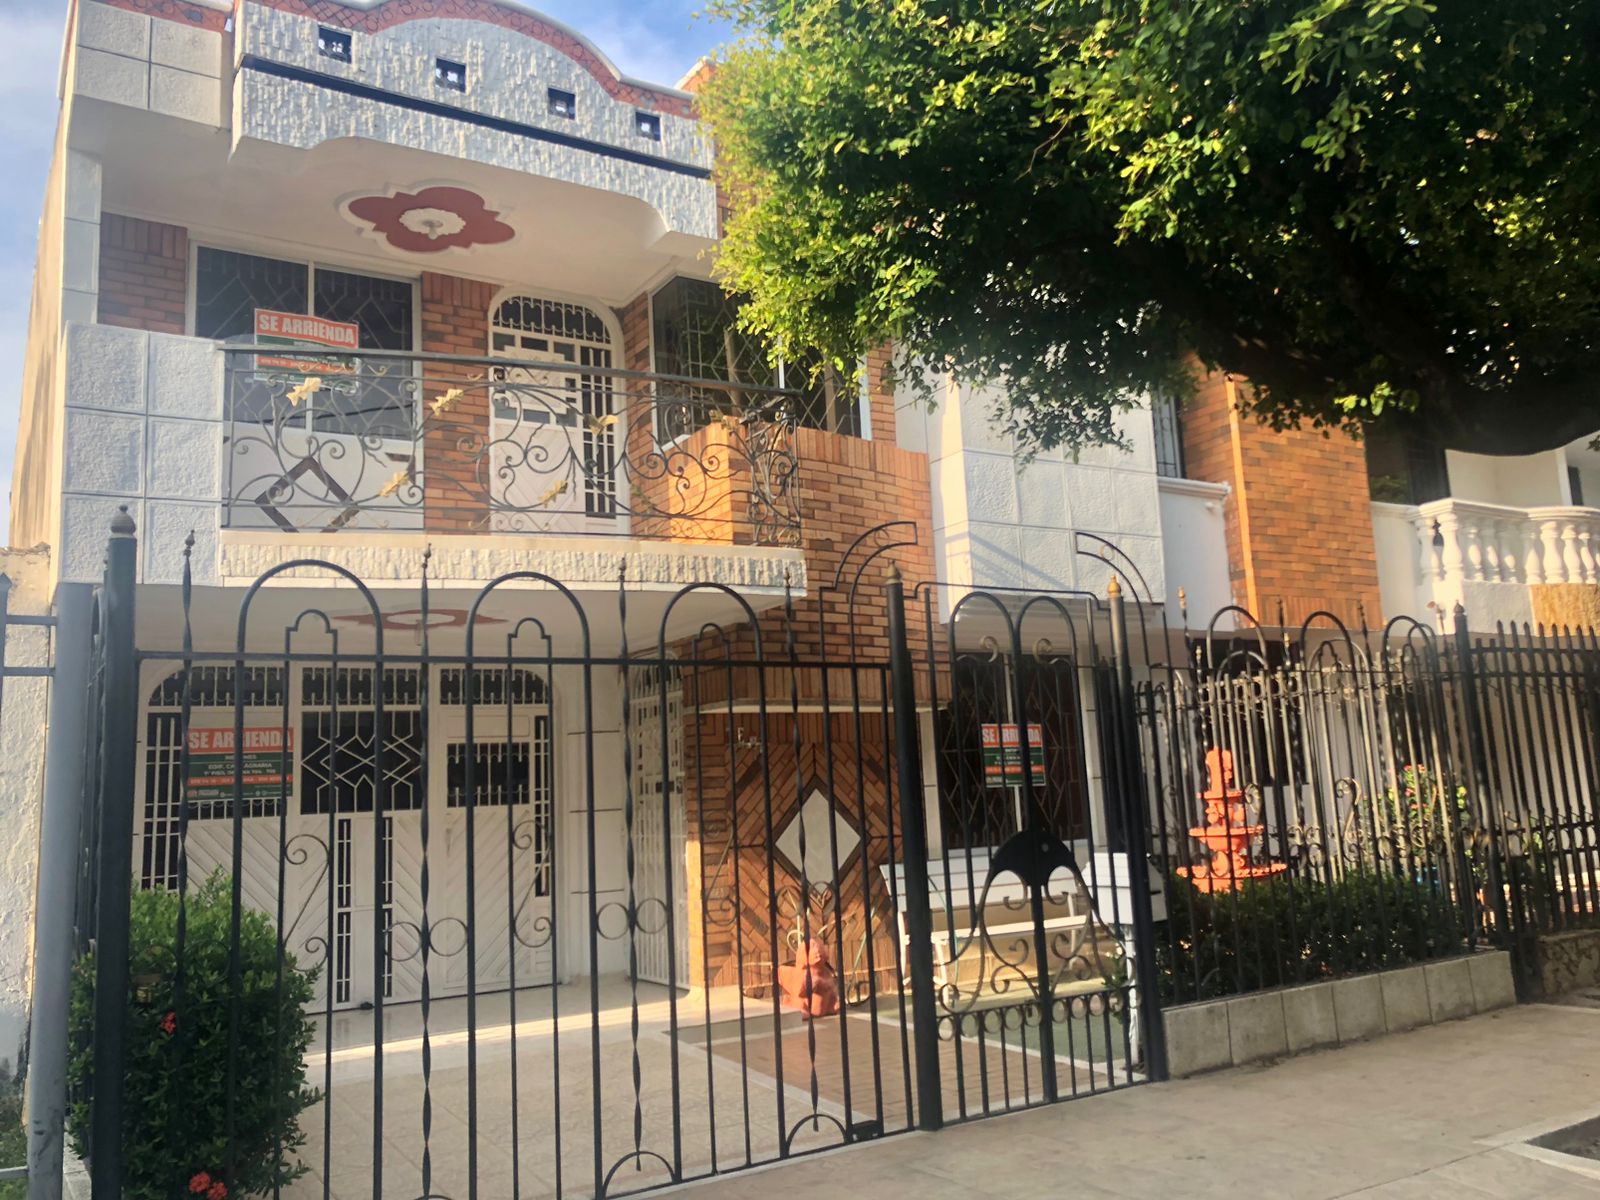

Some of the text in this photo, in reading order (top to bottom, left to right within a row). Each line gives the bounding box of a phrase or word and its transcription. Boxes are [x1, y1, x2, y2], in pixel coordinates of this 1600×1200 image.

[260, 314, 354, 343] SE ARRIENDA
[189, 731, 291, 749] SE ARIENDA
[982, 728, 995, 742] SE
